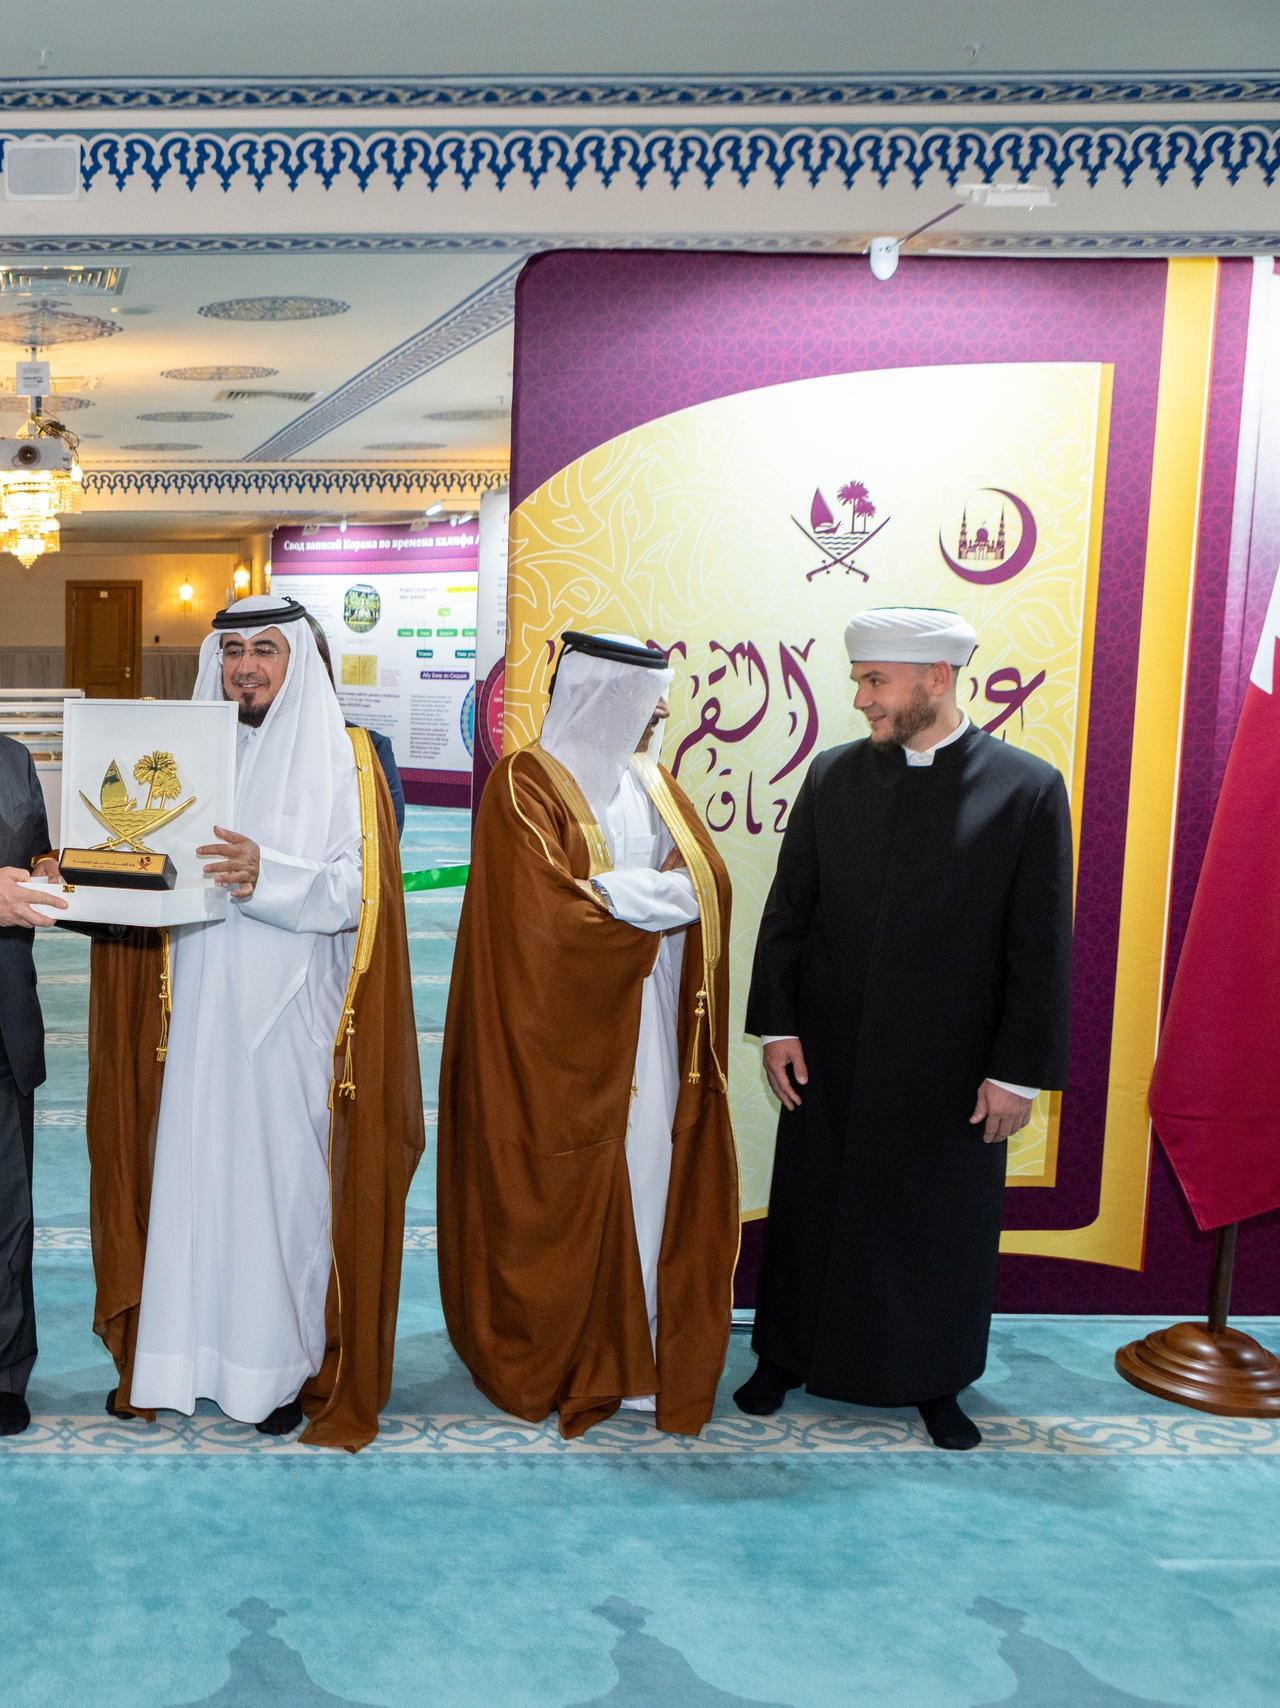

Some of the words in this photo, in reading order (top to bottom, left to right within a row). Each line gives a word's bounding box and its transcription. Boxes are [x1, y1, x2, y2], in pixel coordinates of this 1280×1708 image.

[284, 540, 305, 552] Свод
[305, 538, 342, 551] записей
[343, 538, 377, 552] Корана
[379, 540, 390, 549] во
[392, 537, 434, 551] времена
[435, 533, 474, 548] халифа
